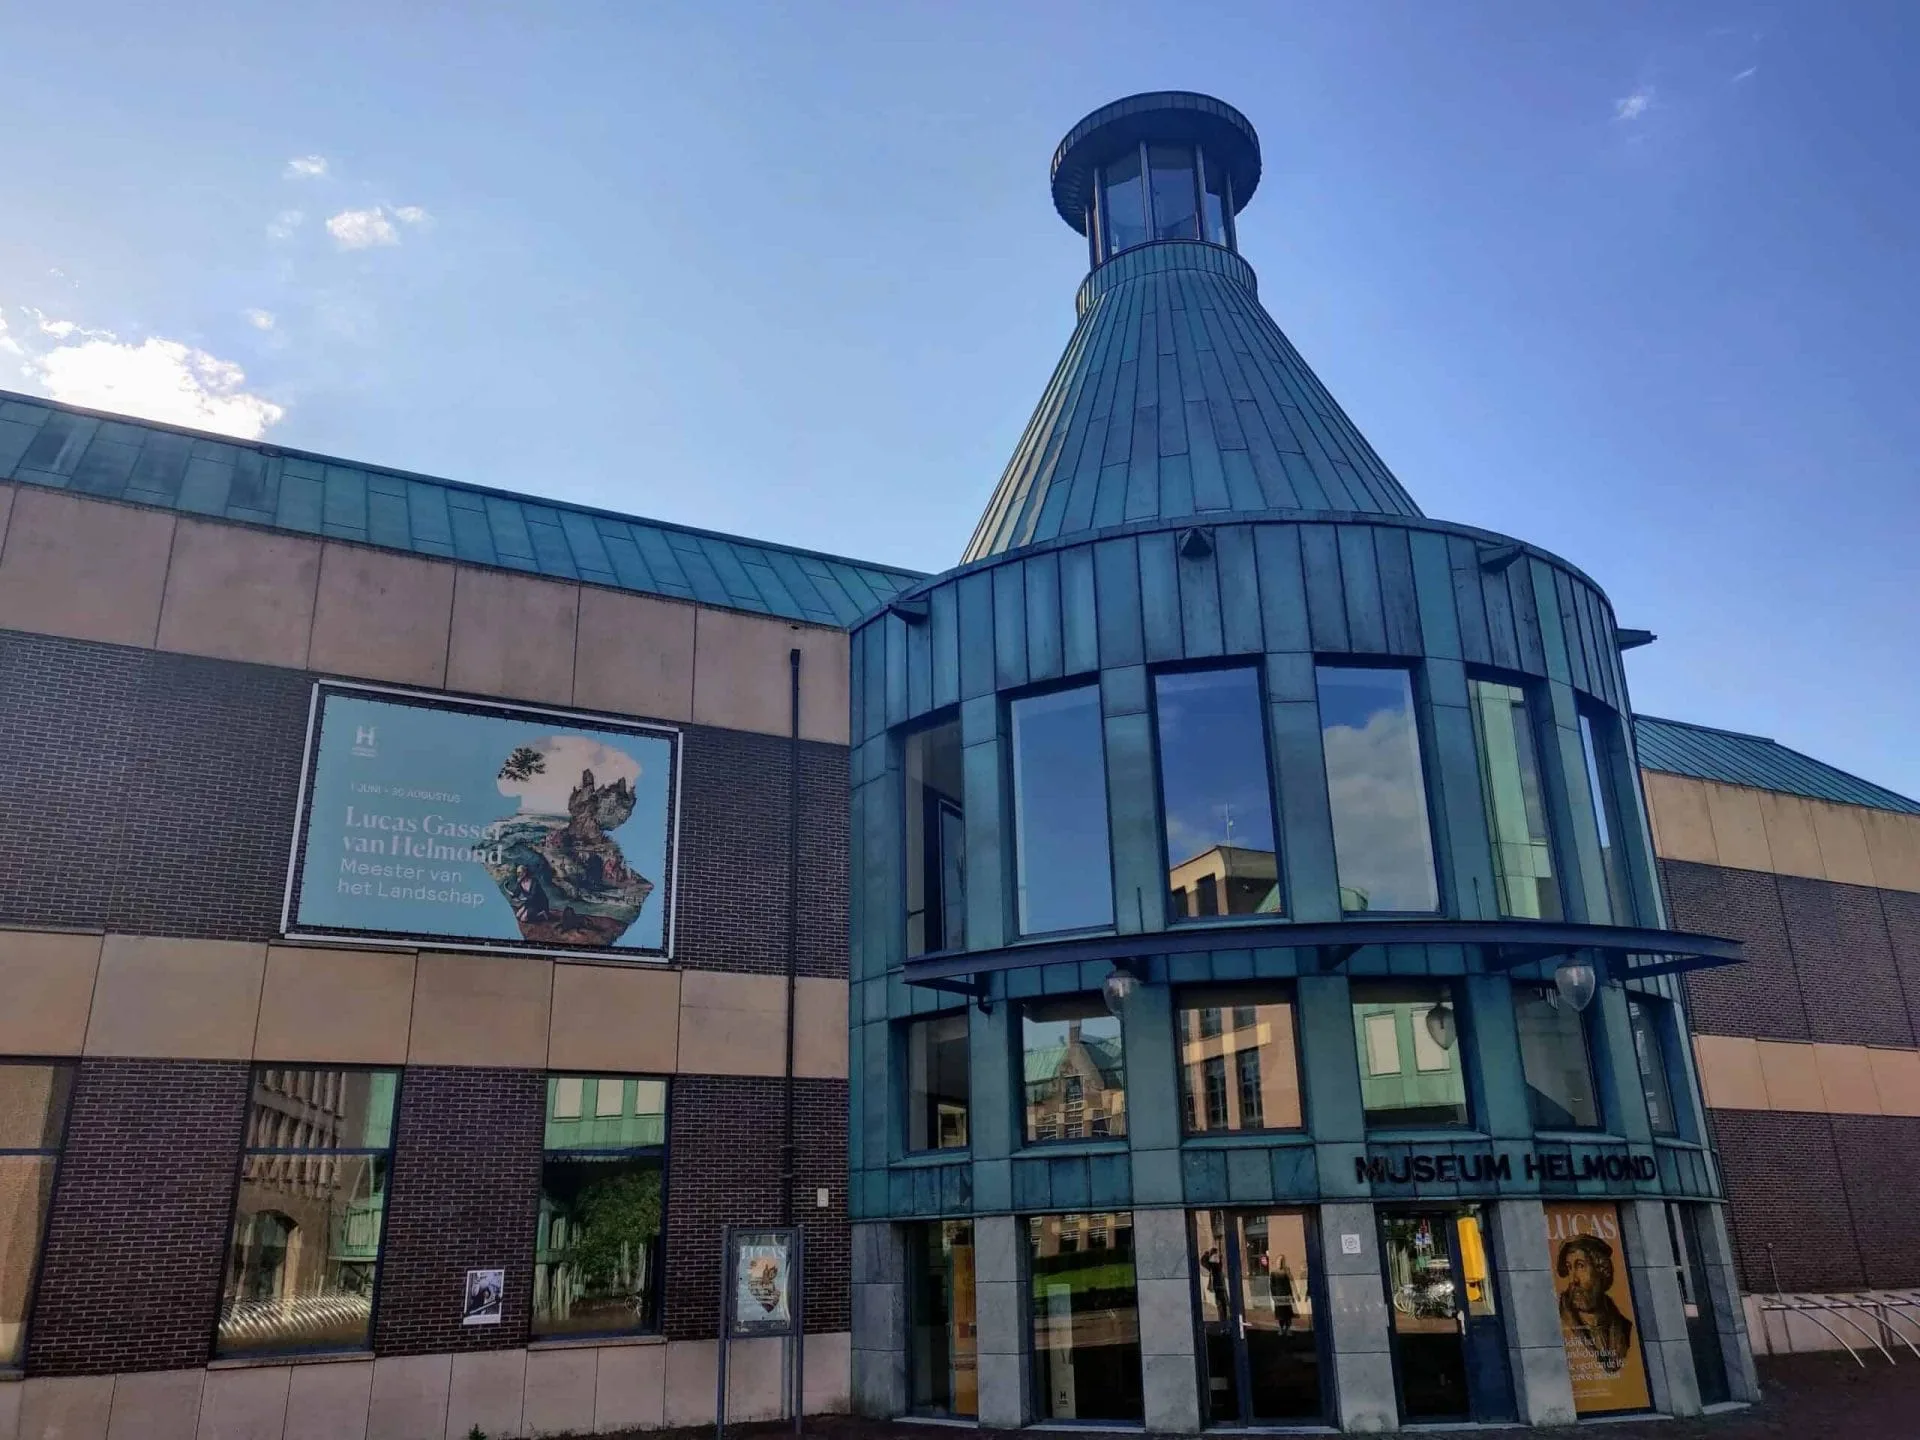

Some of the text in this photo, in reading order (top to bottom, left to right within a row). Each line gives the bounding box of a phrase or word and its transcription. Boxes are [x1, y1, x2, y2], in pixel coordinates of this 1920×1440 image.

[355, 725, 377, 746] H
[357, 783, 382, 794] JUNI
[406, 789, 462, 803] AUGUSTUS
[345, 805, 501, 841] Lucas Gassel
[342, 834, 503, 865] van Helmond
[340, 857, 463, 883] Meester van
[336, 877, 486, 908] het Landschap
[1354, 1153, 1657, 1184] MUSEUM HELMOND
[1543, 1212, 1617, 1240] LUCAS
